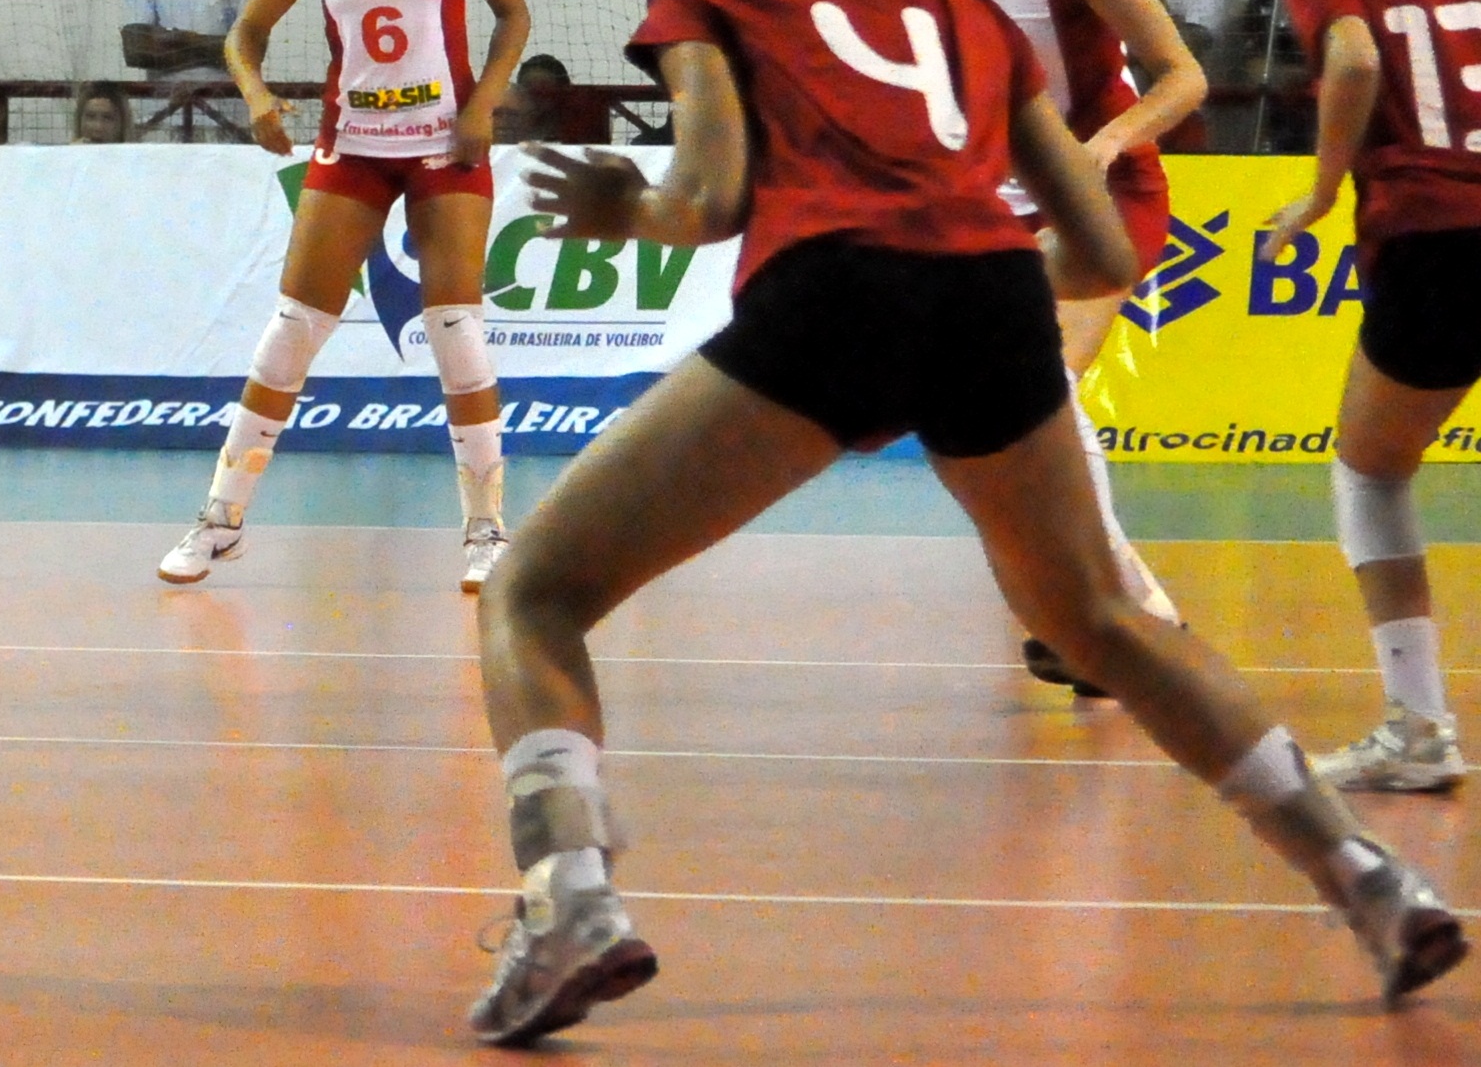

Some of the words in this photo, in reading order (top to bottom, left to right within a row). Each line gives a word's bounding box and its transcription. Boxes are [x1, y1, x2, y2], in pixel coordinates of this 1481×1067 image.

[361, 6, 409, 64] 6
[347, 81, 442, 110] BRASIL
[809, 0, 969, 150] 4
[482, 213, 699, 312] CBV
[509, 331, 581, 347] BRASILEIRA
[585, 331, 601, 347] DE
